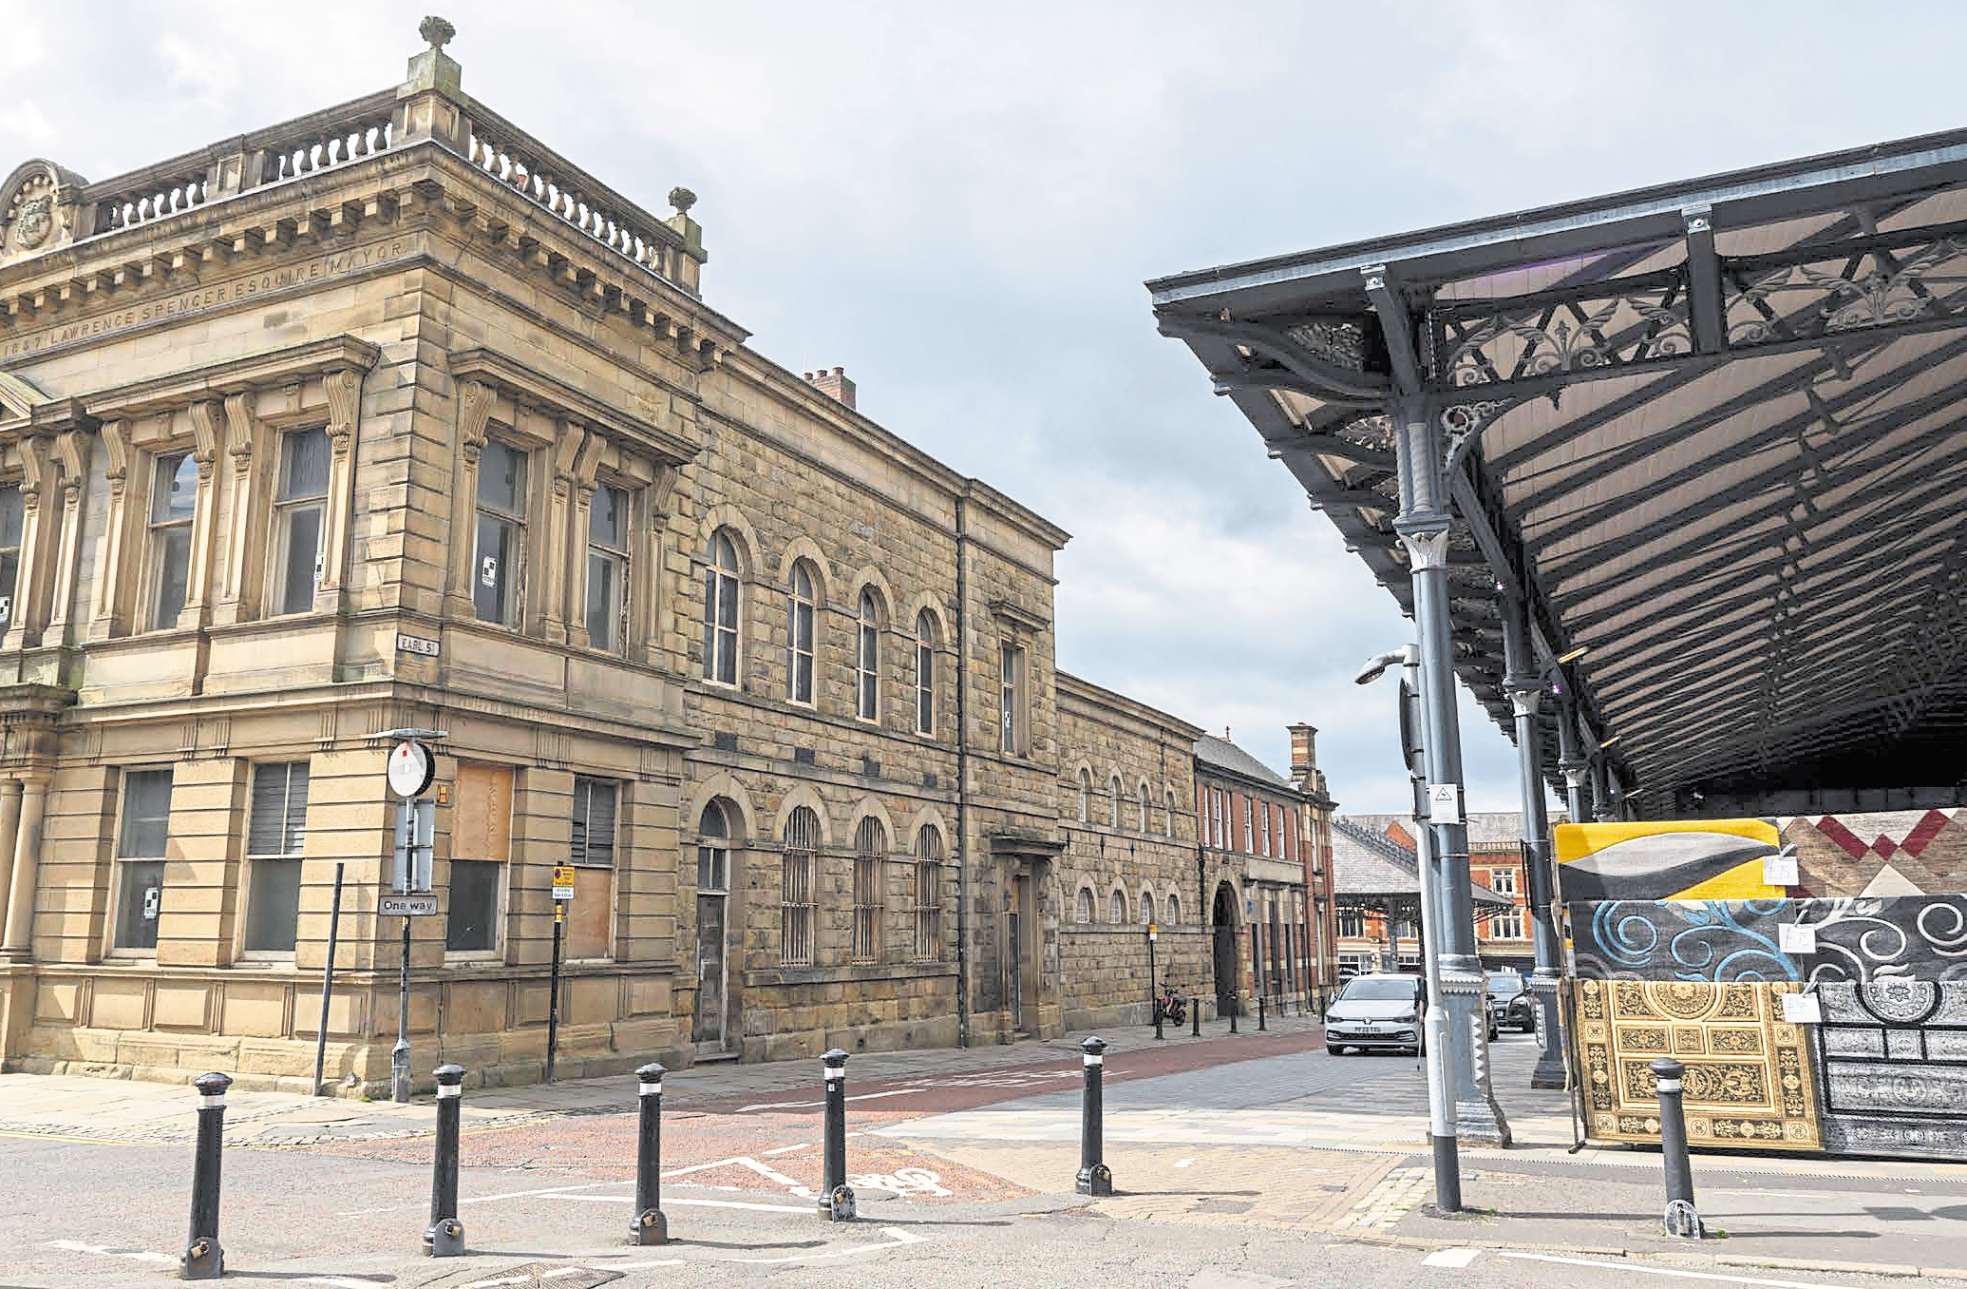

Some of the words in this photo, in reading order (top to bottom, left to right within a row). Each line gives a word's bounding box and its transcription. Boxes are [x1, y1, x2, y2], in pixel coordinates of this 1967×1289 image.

[50, 311, 135, 344] LAWRENCE
[142, 287, 226, 320] SPENCER
[235, 262, 320, 297] ESQUIRE
[402, 638, 424, 651] EARL
[384, 900, 407, 910] One
[409, 902, 432, 911] way
